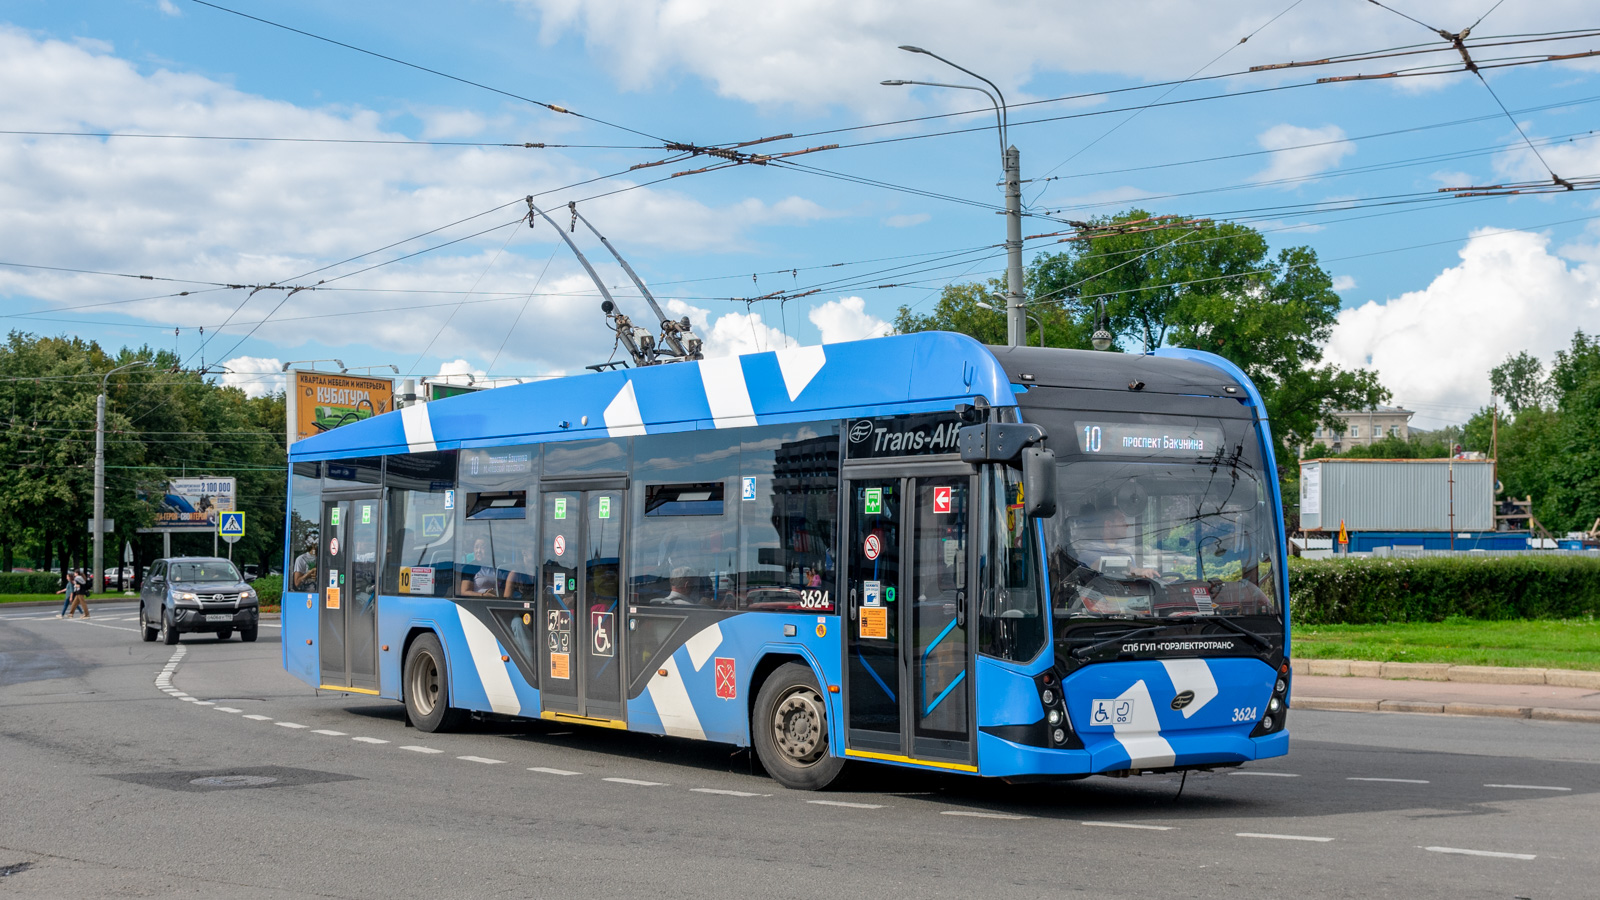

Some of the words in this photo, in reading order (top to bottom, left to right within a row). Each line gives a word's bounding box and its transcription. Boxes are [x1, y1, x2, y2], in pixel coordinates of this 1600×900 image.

[300, 375, 327, 385] КВАРТАЛ
[327, 378, 350, 388] МЕБЕЛИ
[355, 381, 386, 391] ИНТЕРЬЕРА
[317, 386, 370, 407] КУБАТУРА
[874, 422, 961, 452] Trans-Alf
[1084, 425, 1102, 452] 10
[1122, 435, 1161, 449] проспект
[1163, 435, 1204, 450] Бакунина
[471, 456, 479, 475] 10
[200, 482, 206, 492] 2
[206, 482, 217, 492] 100
[218, 482, 231, 492] 000
[401, 572, 410, 586] 10
[800, 589, 830, 608] 3624
[1121, 643, 1139, 652] СПб
[1140, 642, 1157, 651] ГУП
[1157, 641, 1235, 651] «ГОРЭЛЕКТРОТРАНС»
[1232, 706, 1257, 722] 3624
